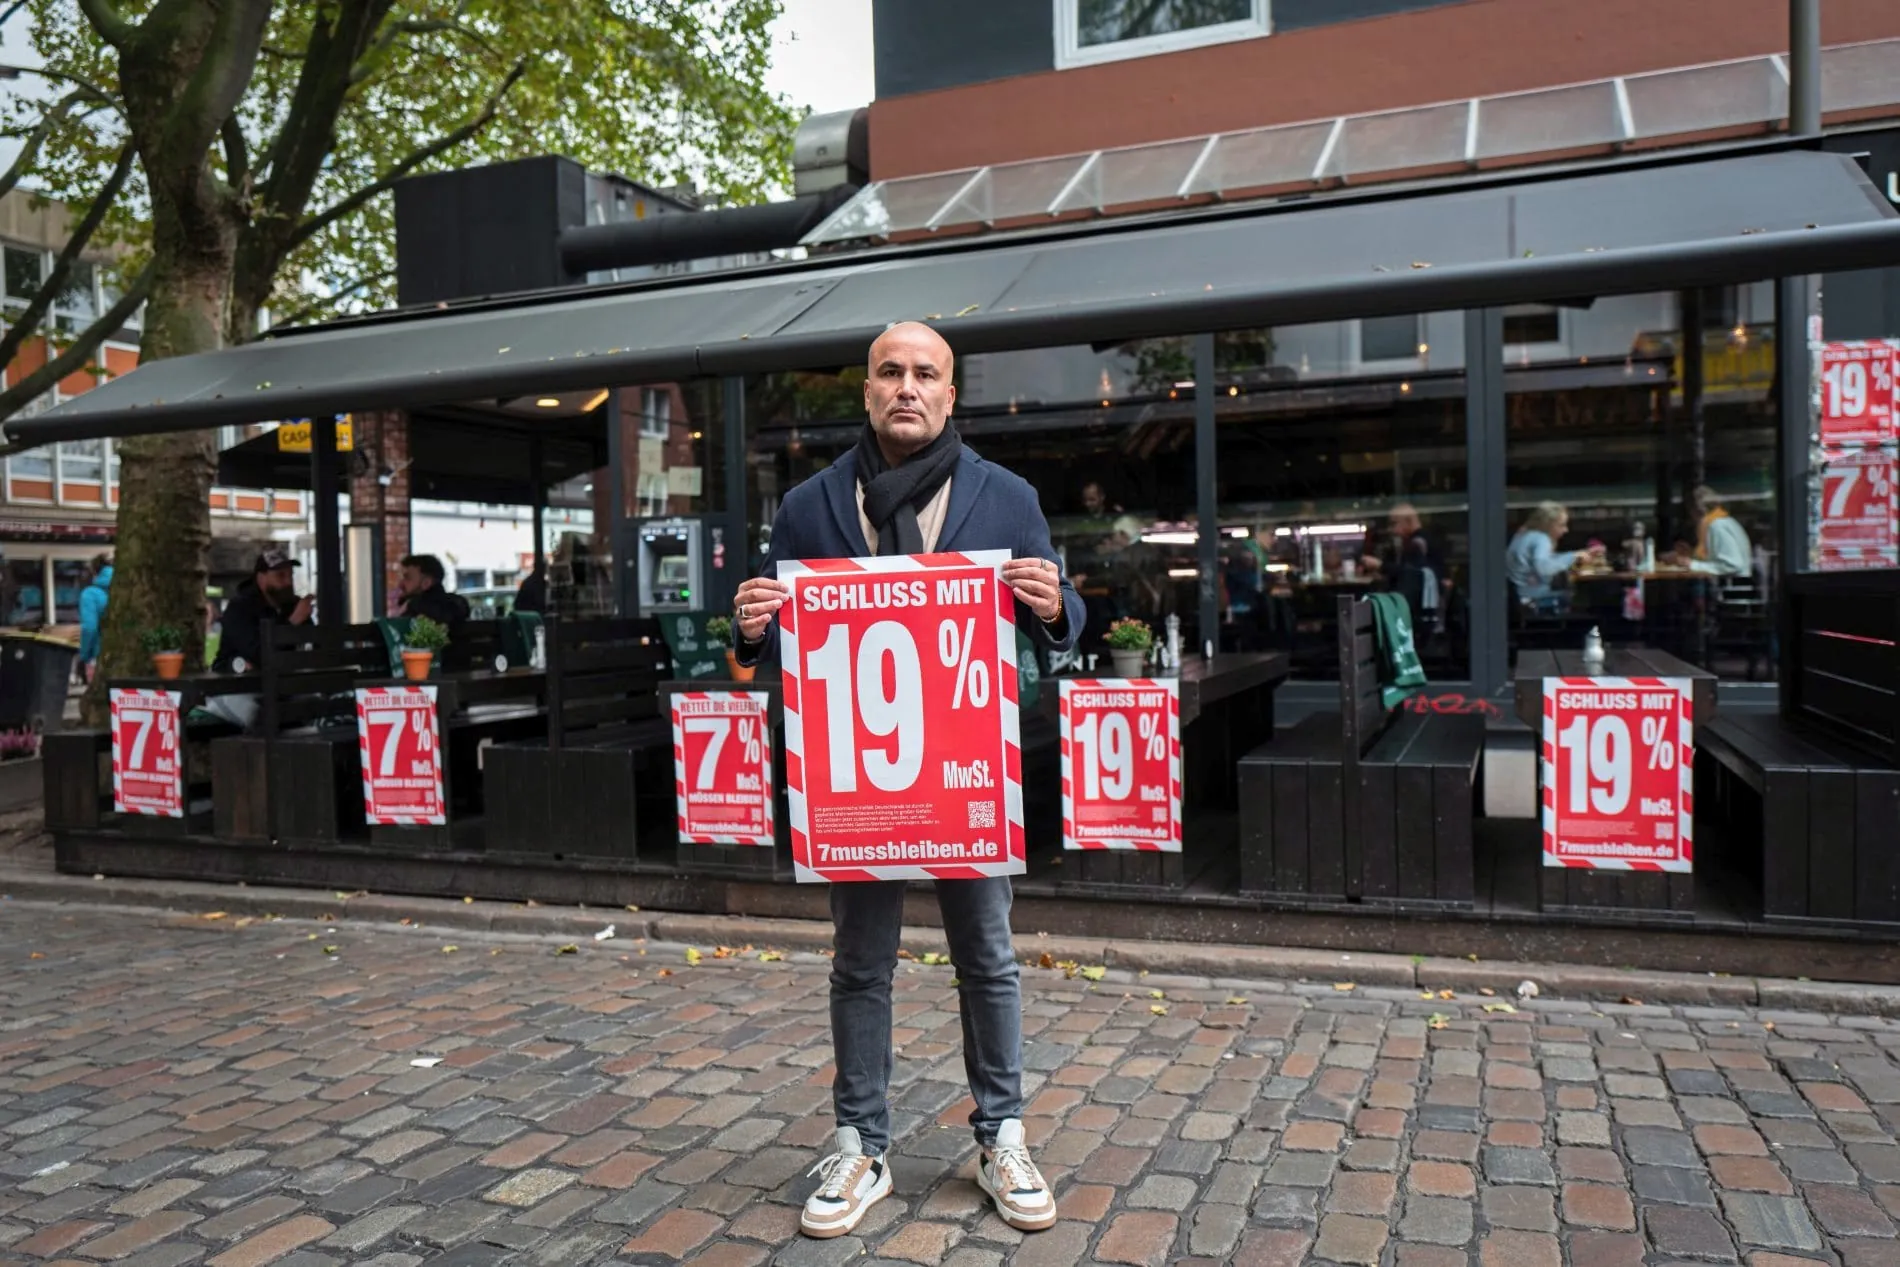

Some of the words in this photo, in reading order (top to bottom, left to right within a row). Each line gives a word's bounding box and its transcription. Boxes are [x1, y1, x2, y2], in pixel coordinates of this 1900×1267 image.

[1823, 362, 1867, 417] 19
[1871, 360, 1891, 391] %
[1823, 467, 1861, 516] 7
[1867, 465, 1888, 497] %
[803, 580, 927, 612] SCHLUSS
[936, 578, 986, 606] MIT
[680, 701, 710, 713] RETTET
[806, 620, 925, 793] 19
[938, 617, 990, 709] %
[1073, 693, 1134, 707] SCHLUSS
[1138, 693, 1165, 707] MIT
[1559, 692, 1637, 710] SCHLUSS
[1641, 693, 1675, 710] MIT
[120, 709, 154, 770] 7
[158, 712, 174, 750] %
[367, 710, 407, 776] 7
[412, 709, 432, 752] %
[685, 718, 731, 790] 7
[737, 717, 761, 764] %
[1074, 712, 1133, 800] 19
[1138, 712, 1166, 761] %
[1559, 714, 1632, 815] 19
[1641, 716, 1675, 770] %
[943, 759, 995, 789] MwSt.
[817, 838, 998, 862] 7mussbleiben.de
[1559, 841, 1674, 858] 7mussbleiben.de
